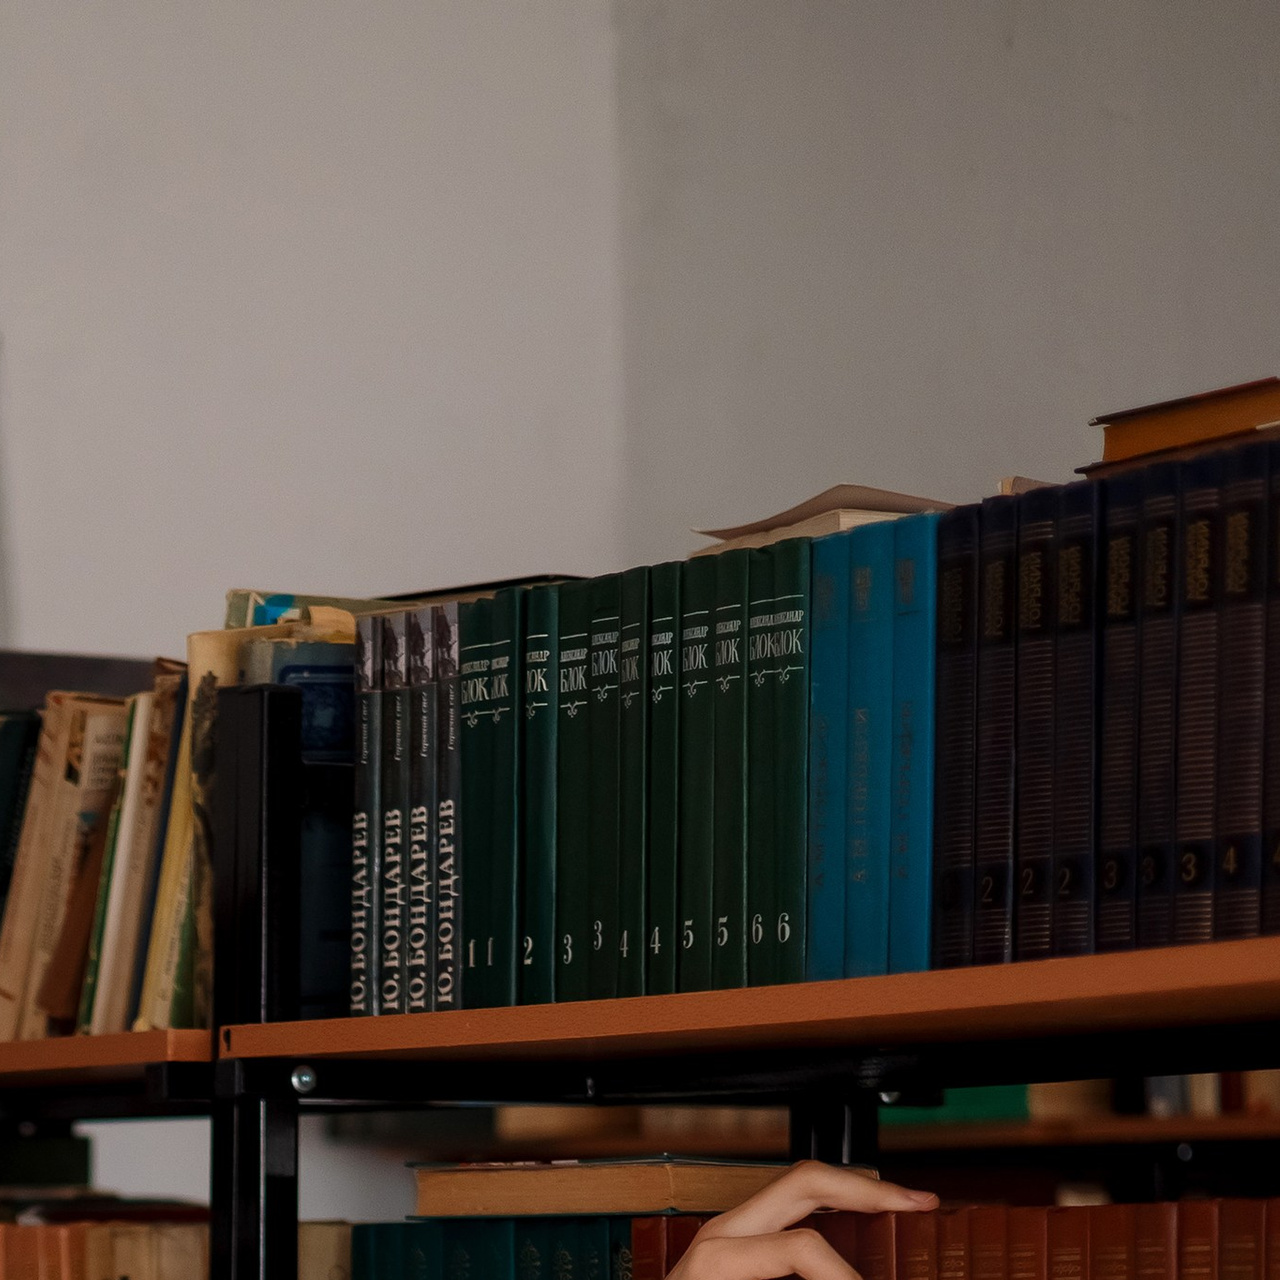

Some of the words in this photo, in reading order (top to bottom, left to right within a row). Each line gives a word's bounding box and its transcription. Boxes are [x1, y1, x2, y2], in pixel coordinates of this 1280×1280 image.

[1029, 552, 1042, 628] ГОРЬКИЙ
[1069, 546, 1081, 623] ГОРЬКИЙ
[682, 644, 709, 672] БЛОК
[715, 638, 741, 667] БЛОК
[773, 628, 804, 658] БЛОК
[592, 649, 619, 677] БЛОК
[560, 665, 588, 693] БЛОК
[1104, 861, 1118, 889] 3
[1181, 852, 1196, 881] 3
[1223, 845, 1237, 875] 4
[350, 811, 372, 969] БОНДАРЕВ
[382, 808, 405, 967] БОНДАРЕВ
[407, 805, 431, 966] БОНДАРЕВ
[437, 799, 460, 959] БОНДАРЕВ
[982, 876, 993, 902] 2
[1022, 867, 1034, 895] 2
[1060, 867, 1070, 894] 2
[593, 920, 602, 950] 3
[650, 926, 661, 955] 4
[683, 920, 694, 949] 5
[717, 916, 728, 946] 5
[752, 914, 763, 945] 6
[777, 912, 790, 943] 6
[468, 939, 476, 968] 1
[487, 936, 494, 966] 1
[523, 936, 533, 965] 2
[563, 934, 573, 965] 3
[620, 930, 628, 958] 4
[350, 975, 368, 1011] Ю.
[382, 973, 401, 1010] Ю.
[408, 971, 426, 1008] Ю.
[437, 966, 454, 1003] Ю.
